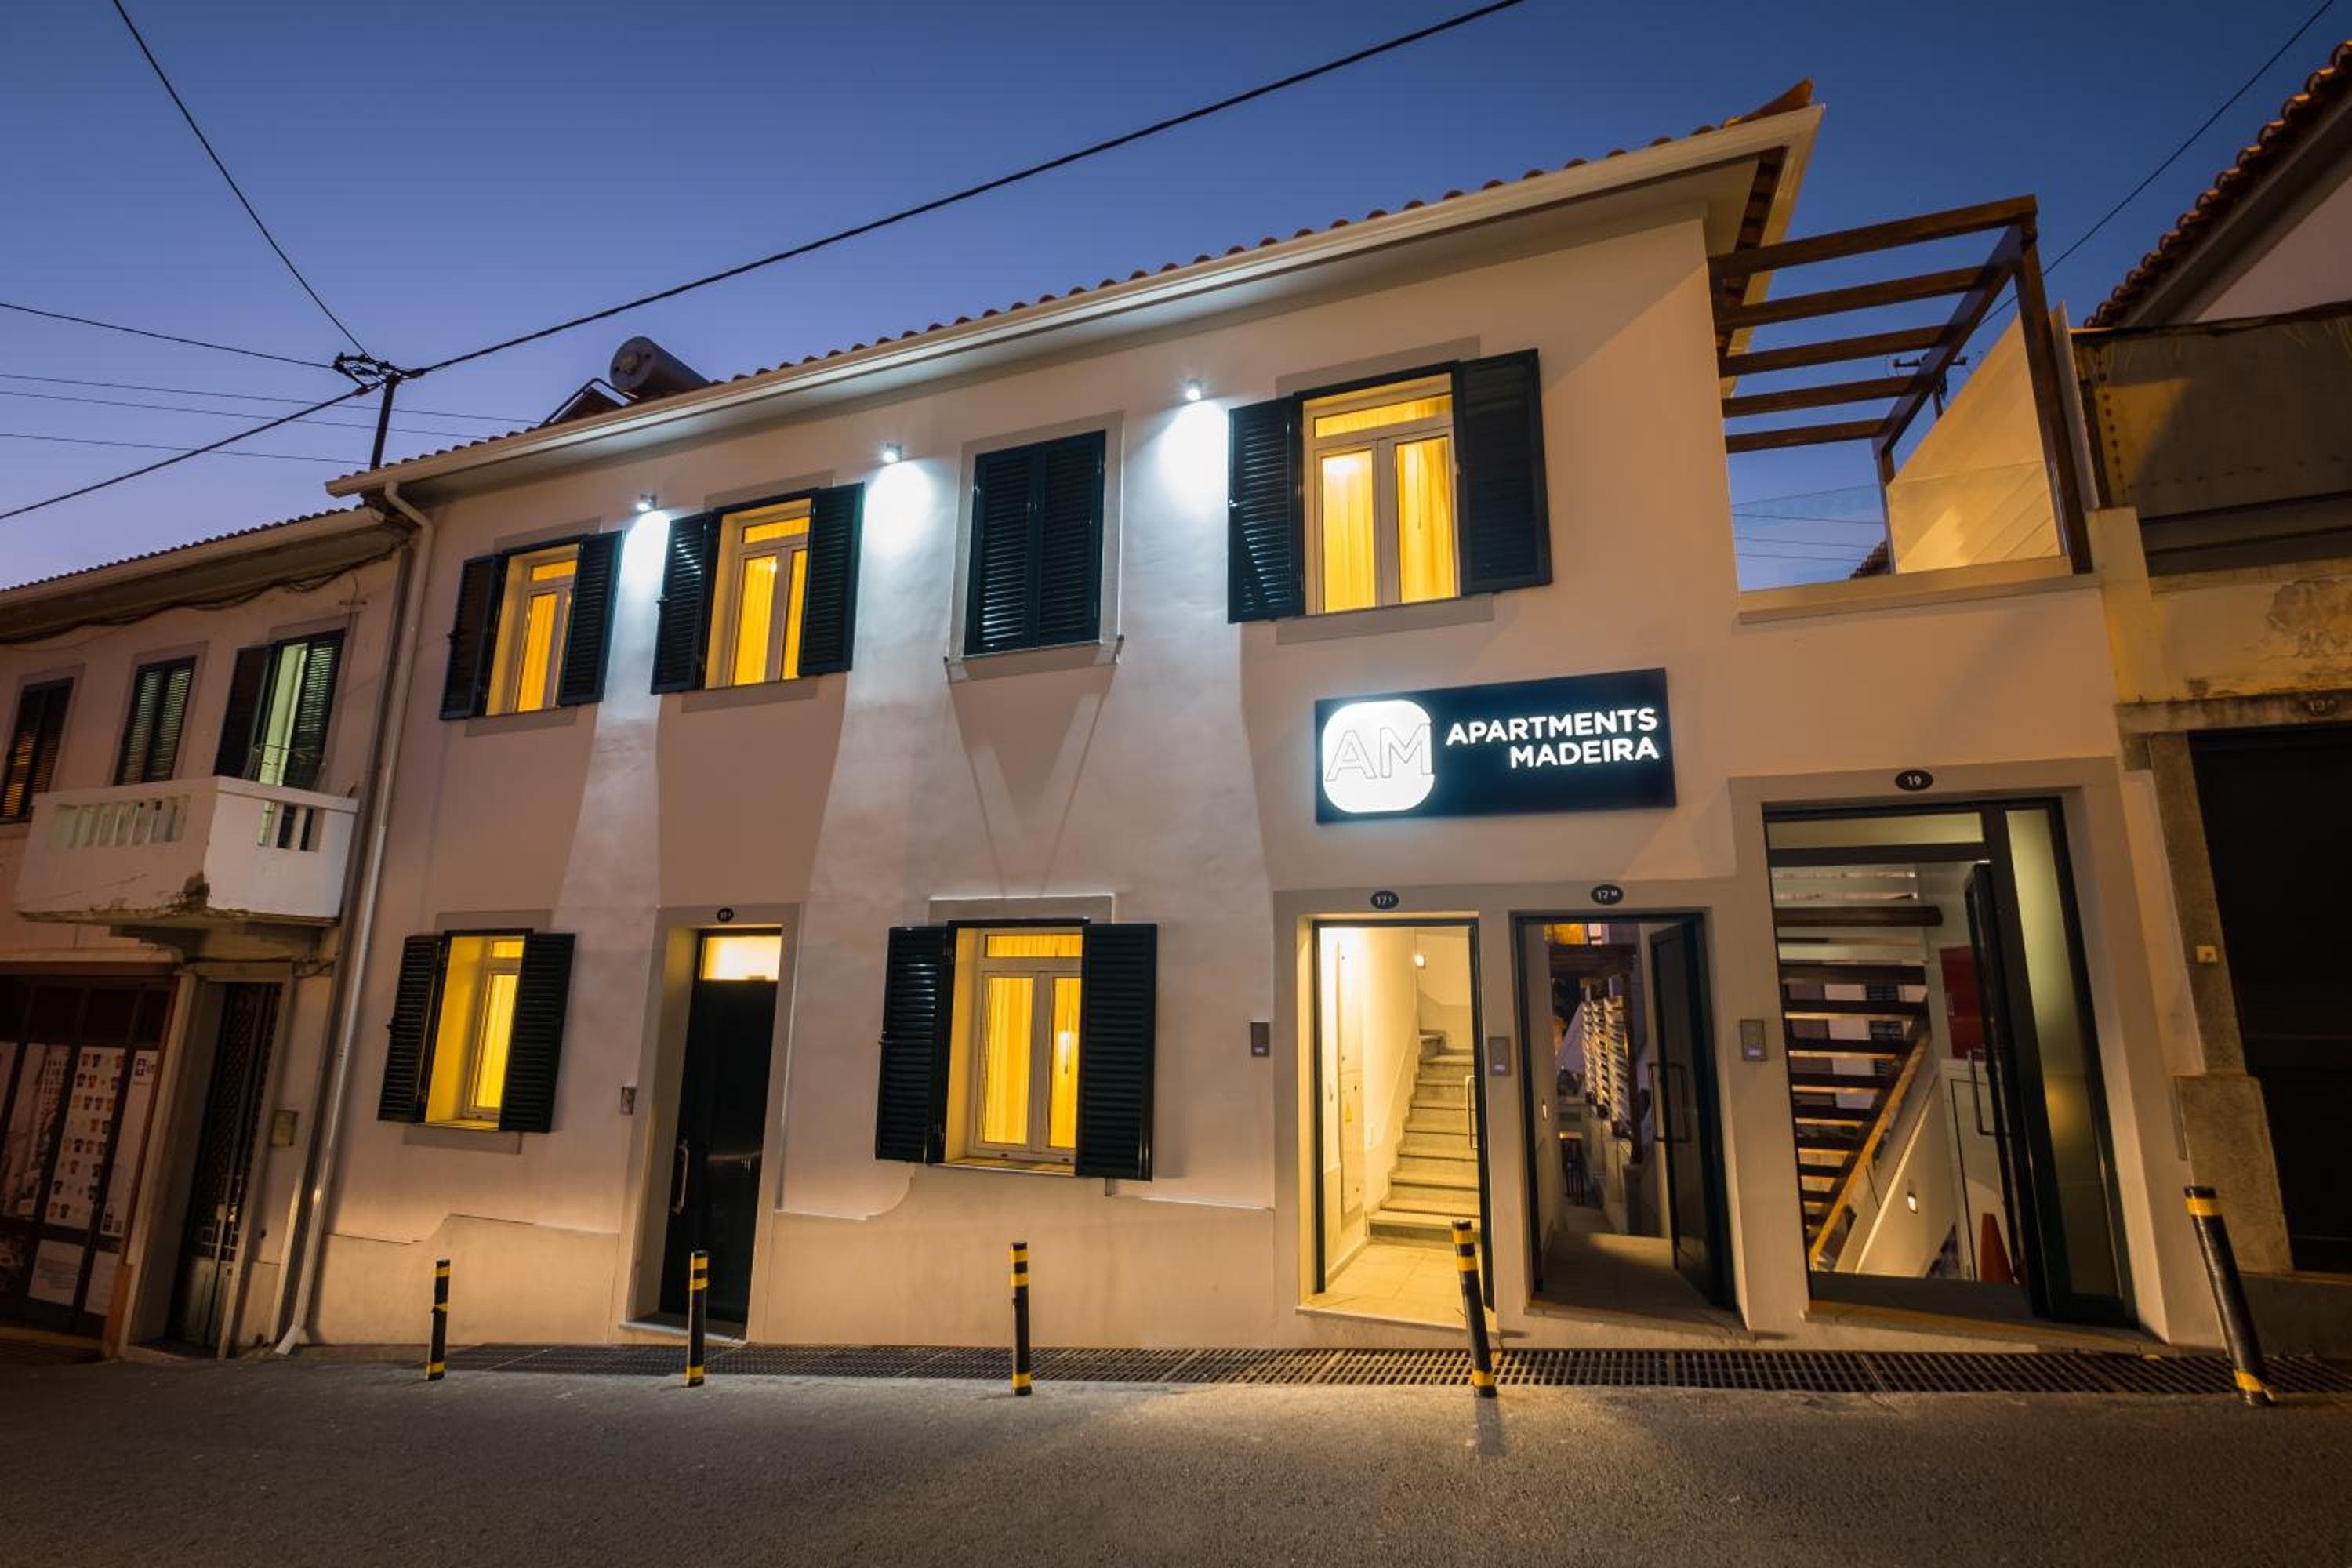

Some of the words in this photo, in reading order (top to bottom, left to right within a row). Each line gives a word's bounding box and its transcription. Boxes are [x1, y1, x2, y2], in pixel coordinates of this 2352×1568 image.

[1446, 707, 1658, 746] APARTMENTS
[1325, 722, 1432, 782] AM
[1510, 736, 1660, 769] MADEIRA
[1906, 775, 1922, 786] 19
